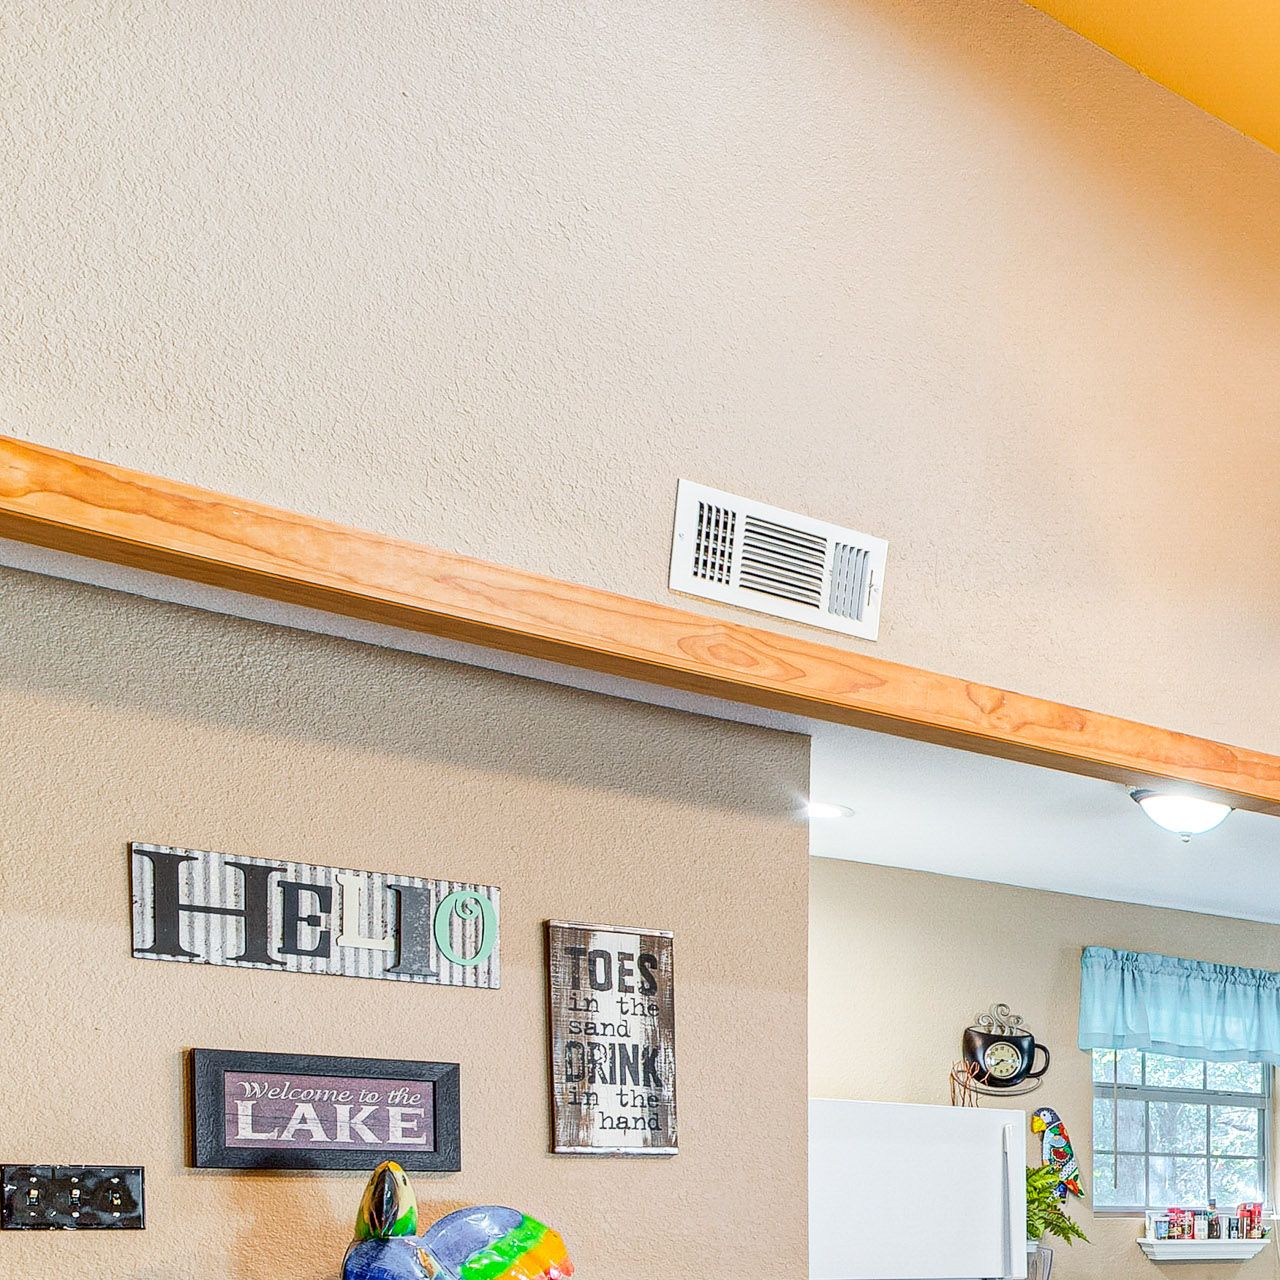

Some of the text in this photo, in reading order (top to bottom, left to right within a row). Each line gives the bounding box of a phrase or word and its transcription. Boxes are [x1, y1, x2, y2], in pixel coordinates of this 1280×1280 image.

[564, 946, 658, 996] TOES
[568, 993, 660, 1017] in the
[568, 1019, 631, 1038] sand
[565, 1040, 663, 1088] DRINK
[238, 1081, 422, 1106] Welcome to the
[568, 1086, 660, 1108] in the
[234, 1100, 427, 1145] LAKE
[599, 1111, 662, 1131] hand
